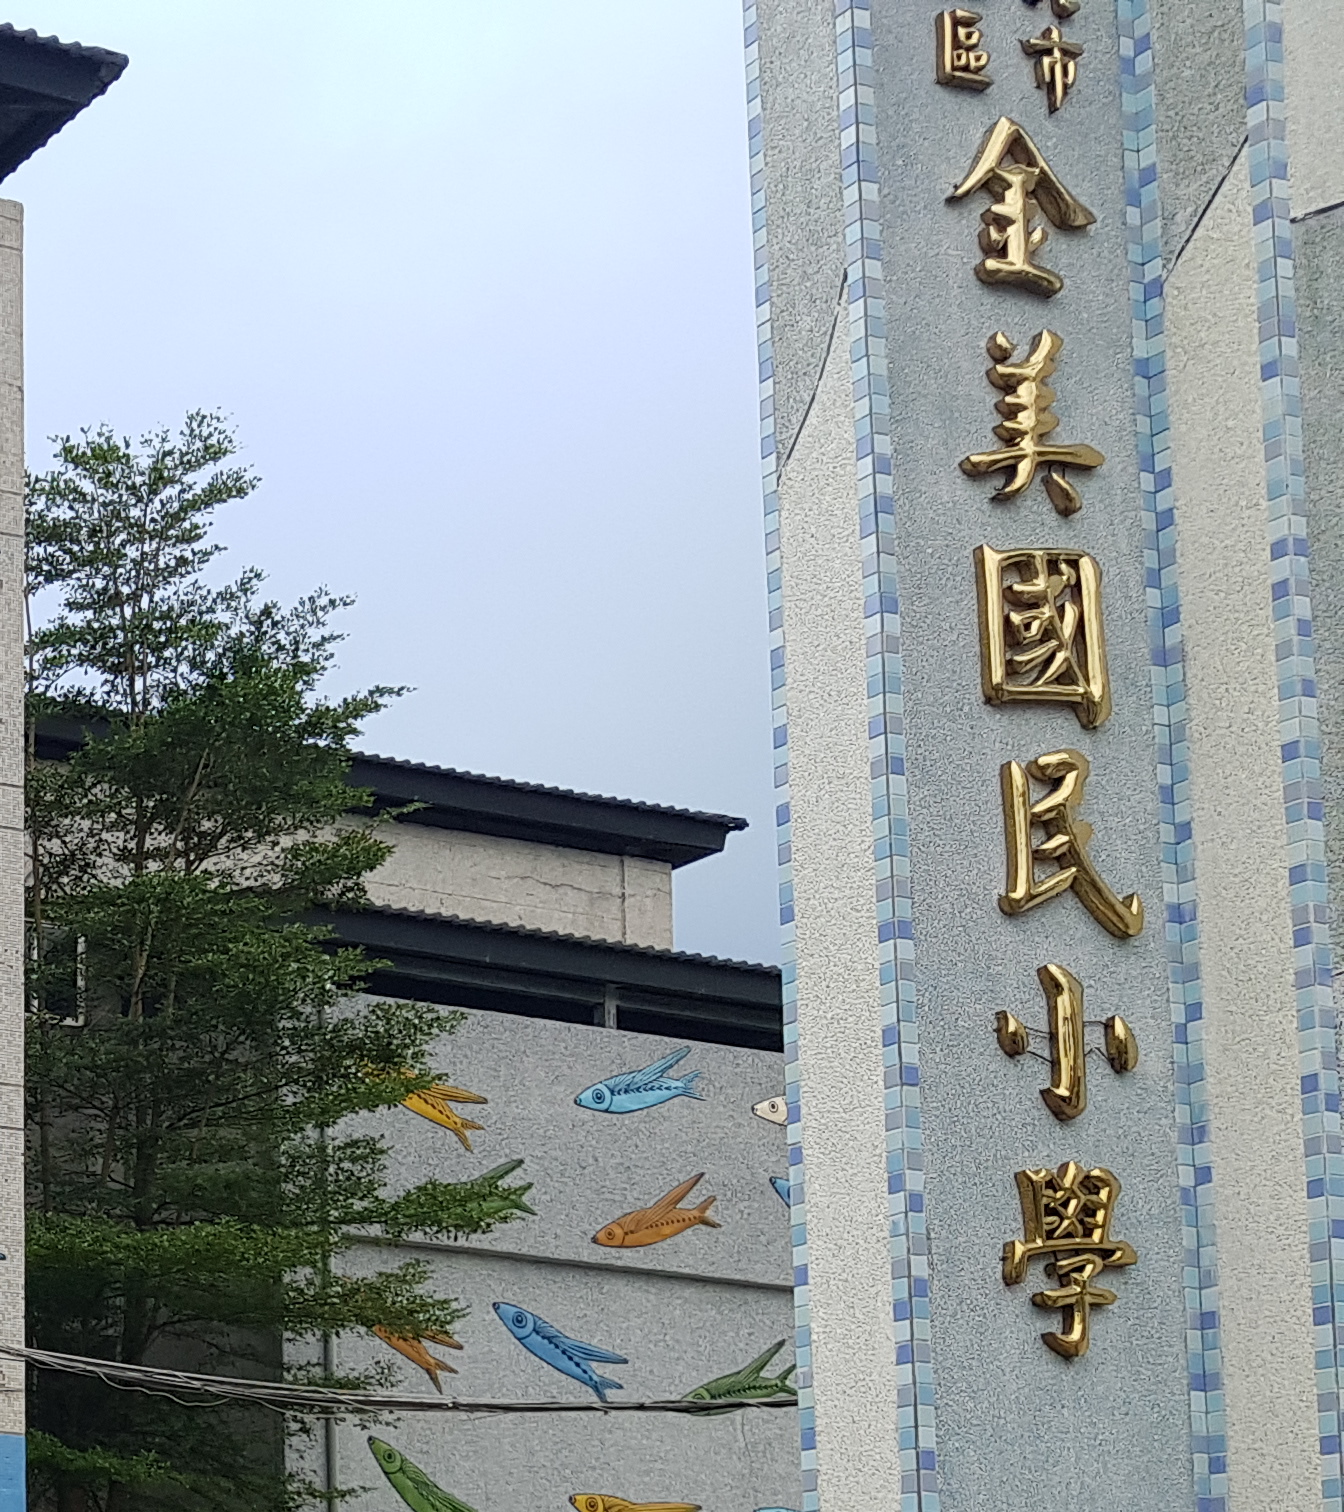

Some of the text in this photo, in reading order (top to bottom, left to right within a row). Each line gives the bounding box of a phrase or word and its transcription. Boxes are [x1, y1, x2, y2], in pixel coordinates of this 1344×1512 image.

[935, 9, 994, 92] 區
[945, 116, 1144, 1361] 金美國民小學
